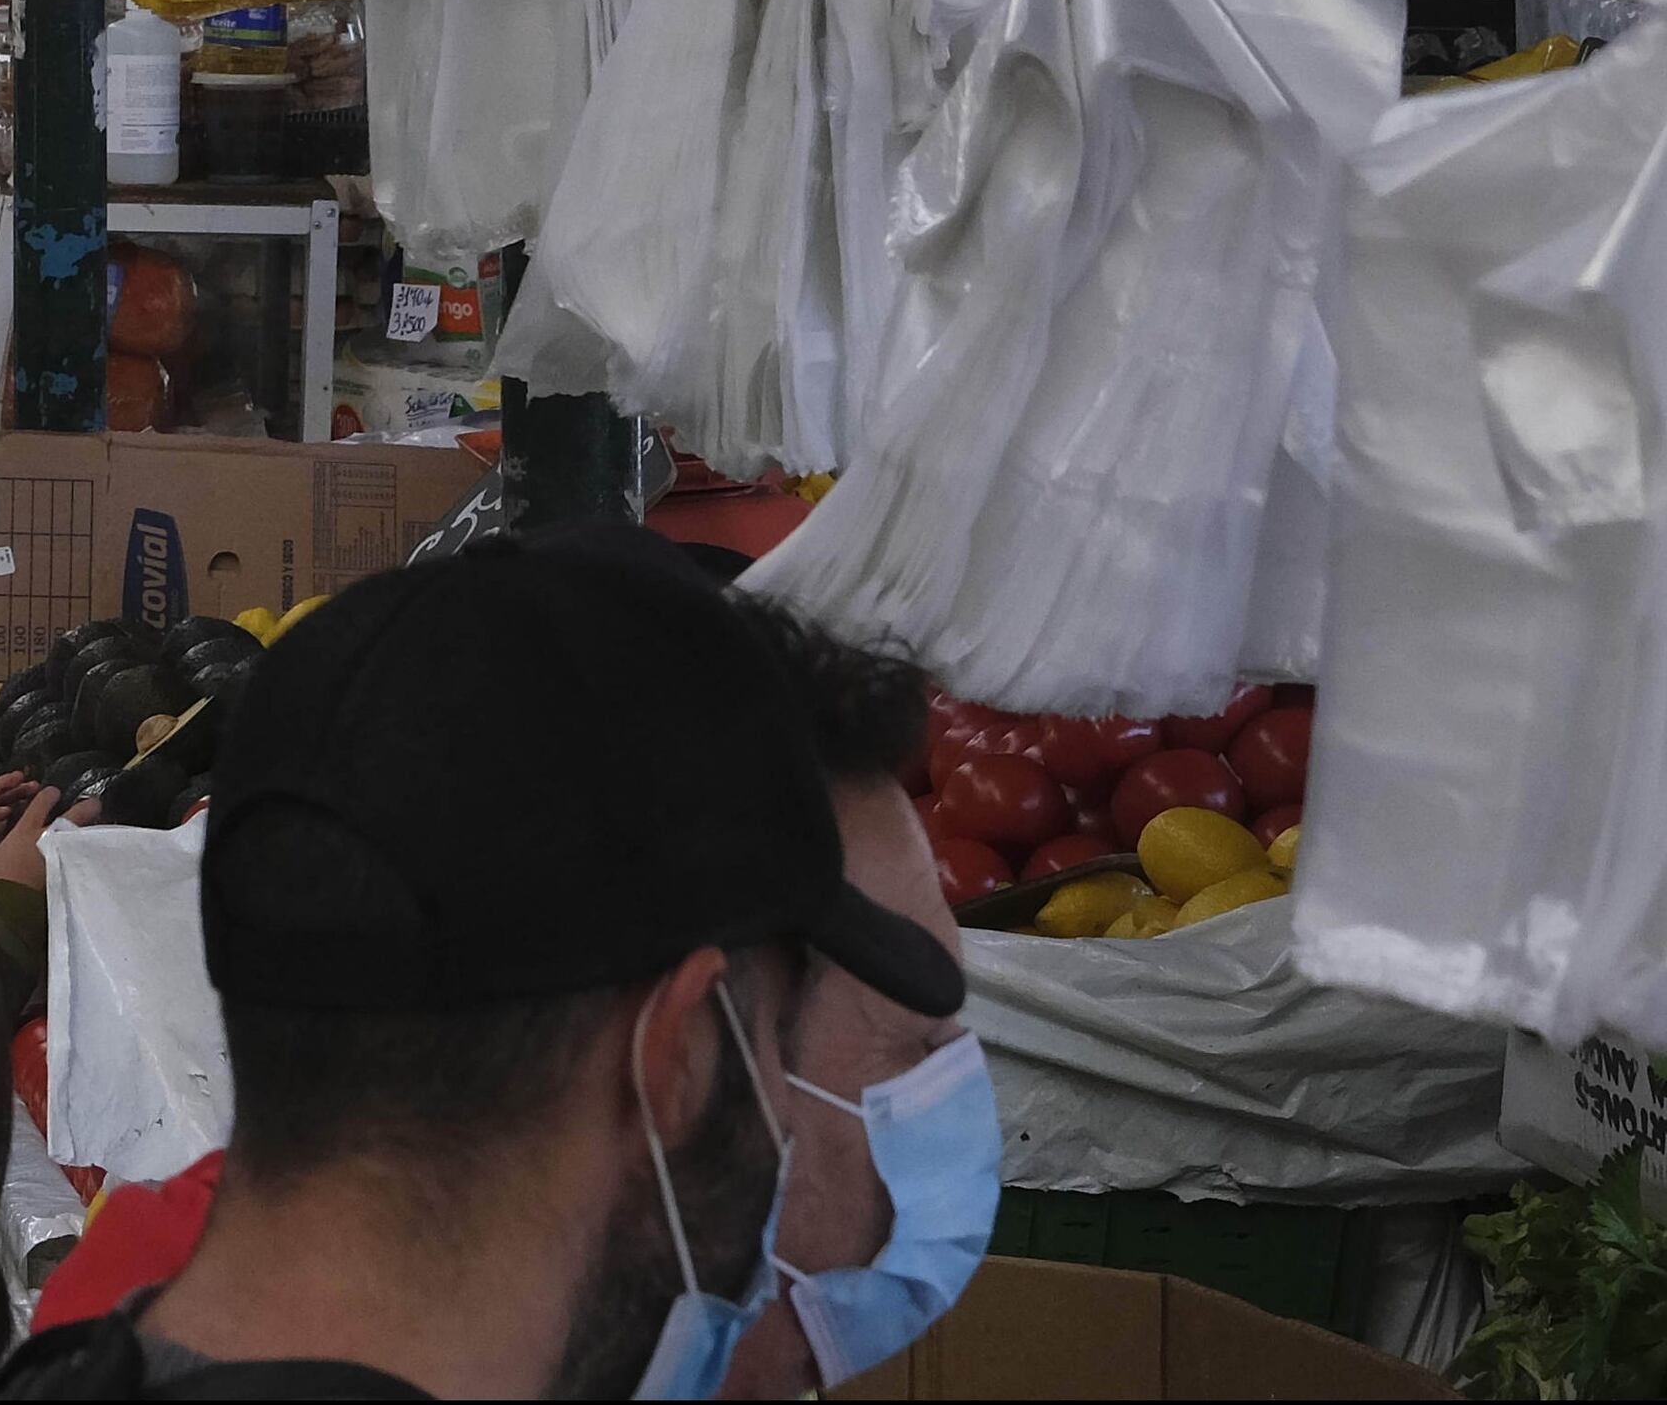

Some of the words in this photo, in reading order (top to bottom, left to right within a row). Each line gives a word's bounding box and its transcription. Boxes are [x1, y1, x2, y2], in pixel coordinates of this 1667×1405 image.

[441, 301, 474, 320] ngo
[14, 625, 26, 656] 100
[33, 626, 46, 656] 180
[1574, 1071, 1667, 1156] RTONES
